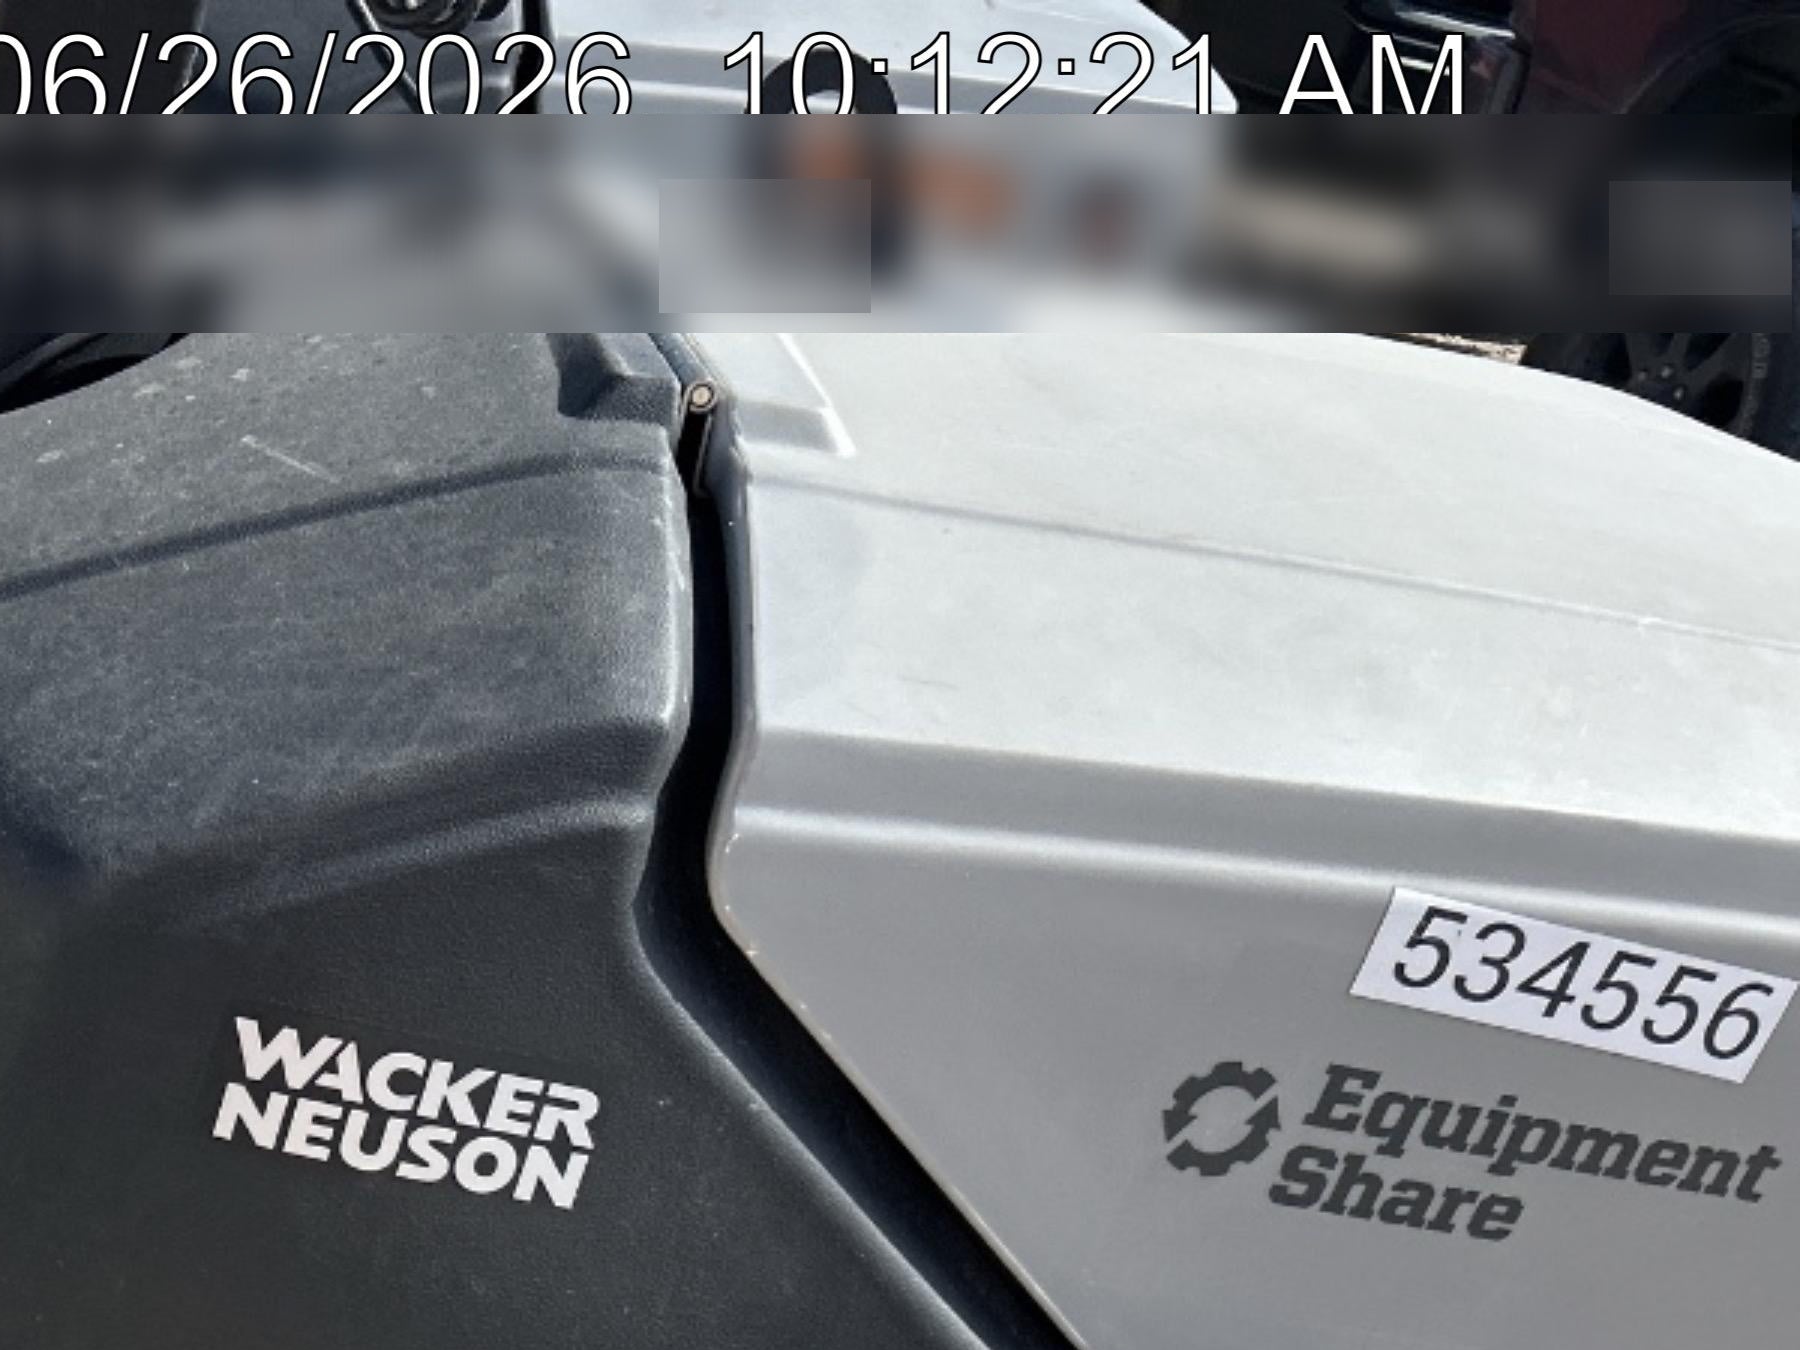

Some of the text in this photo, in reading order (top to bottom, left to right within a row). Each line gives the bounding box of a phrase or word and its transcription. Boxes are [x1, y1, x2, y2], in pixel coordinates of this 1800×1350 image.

[1393, 906, 1774, 1060] 534556
[213, 1082, 589, 1209] NEUSON
[235, 1016, 599, 1149] WACKER
[1303, 1063, 1781, 1202] Equipment
[1268, 1145, 1524, 1242] Share
